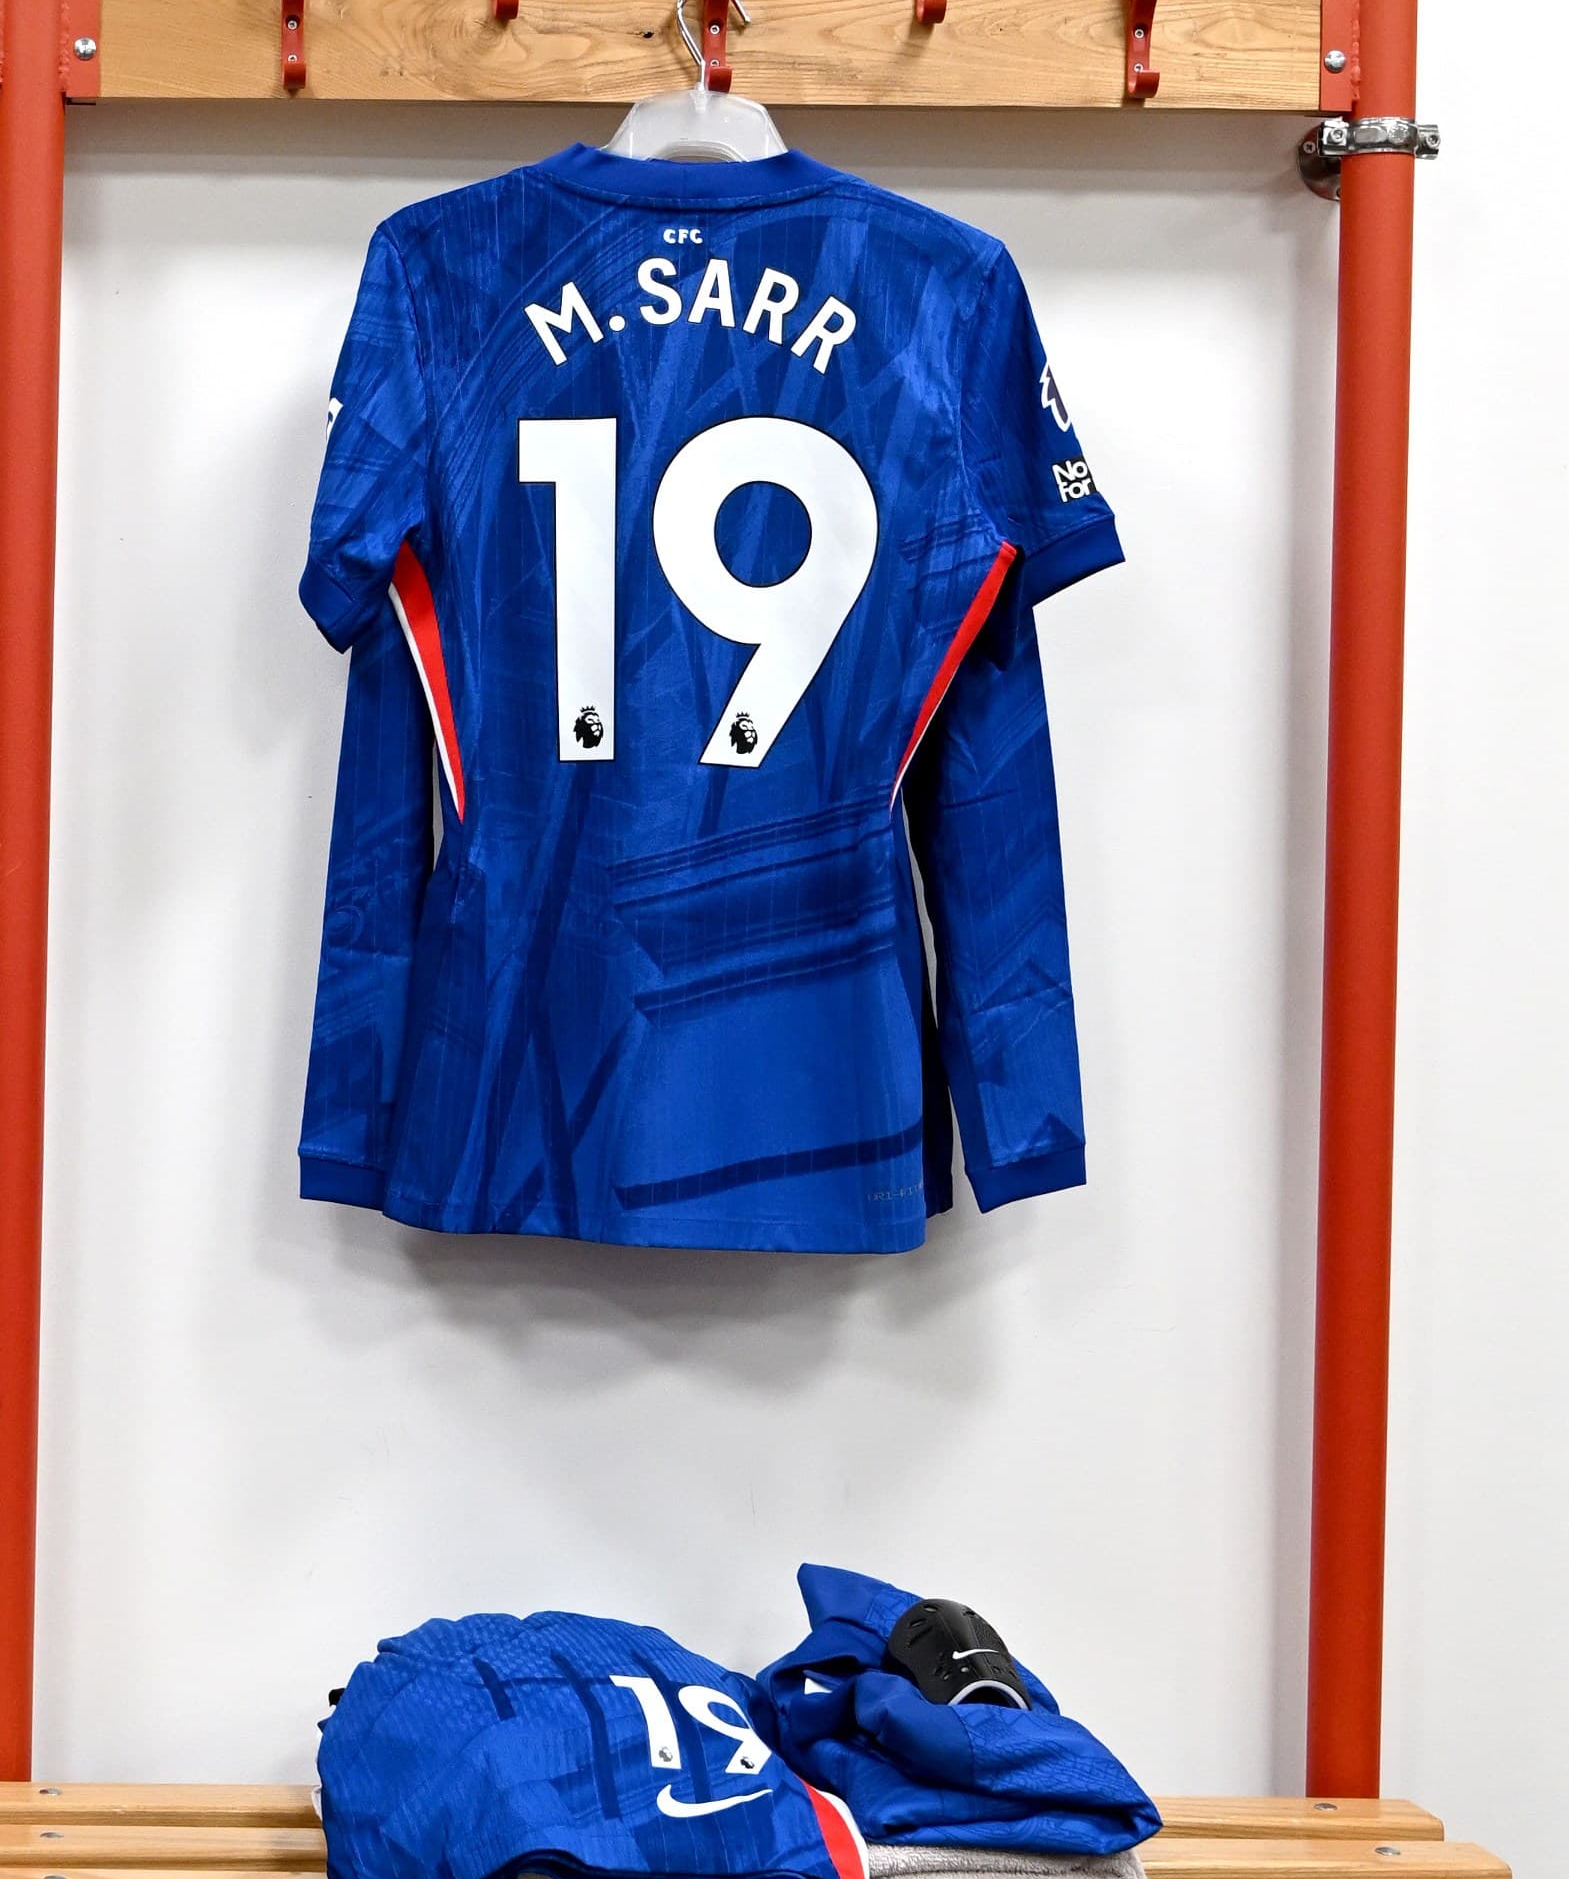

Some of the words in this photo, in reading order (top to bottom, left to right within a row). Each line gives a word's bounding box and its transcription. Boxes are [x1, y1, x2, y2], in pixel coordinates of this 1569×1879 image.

[663, 228, 703, 245] CFC
[524, 258, 857, 375] M.SARR
[1052, 460, 1088, 484] No
[1059, 478, 1091, 502] for
[517, 416, 879, 767] 19
[610, 1675, 773, 1774] 19
